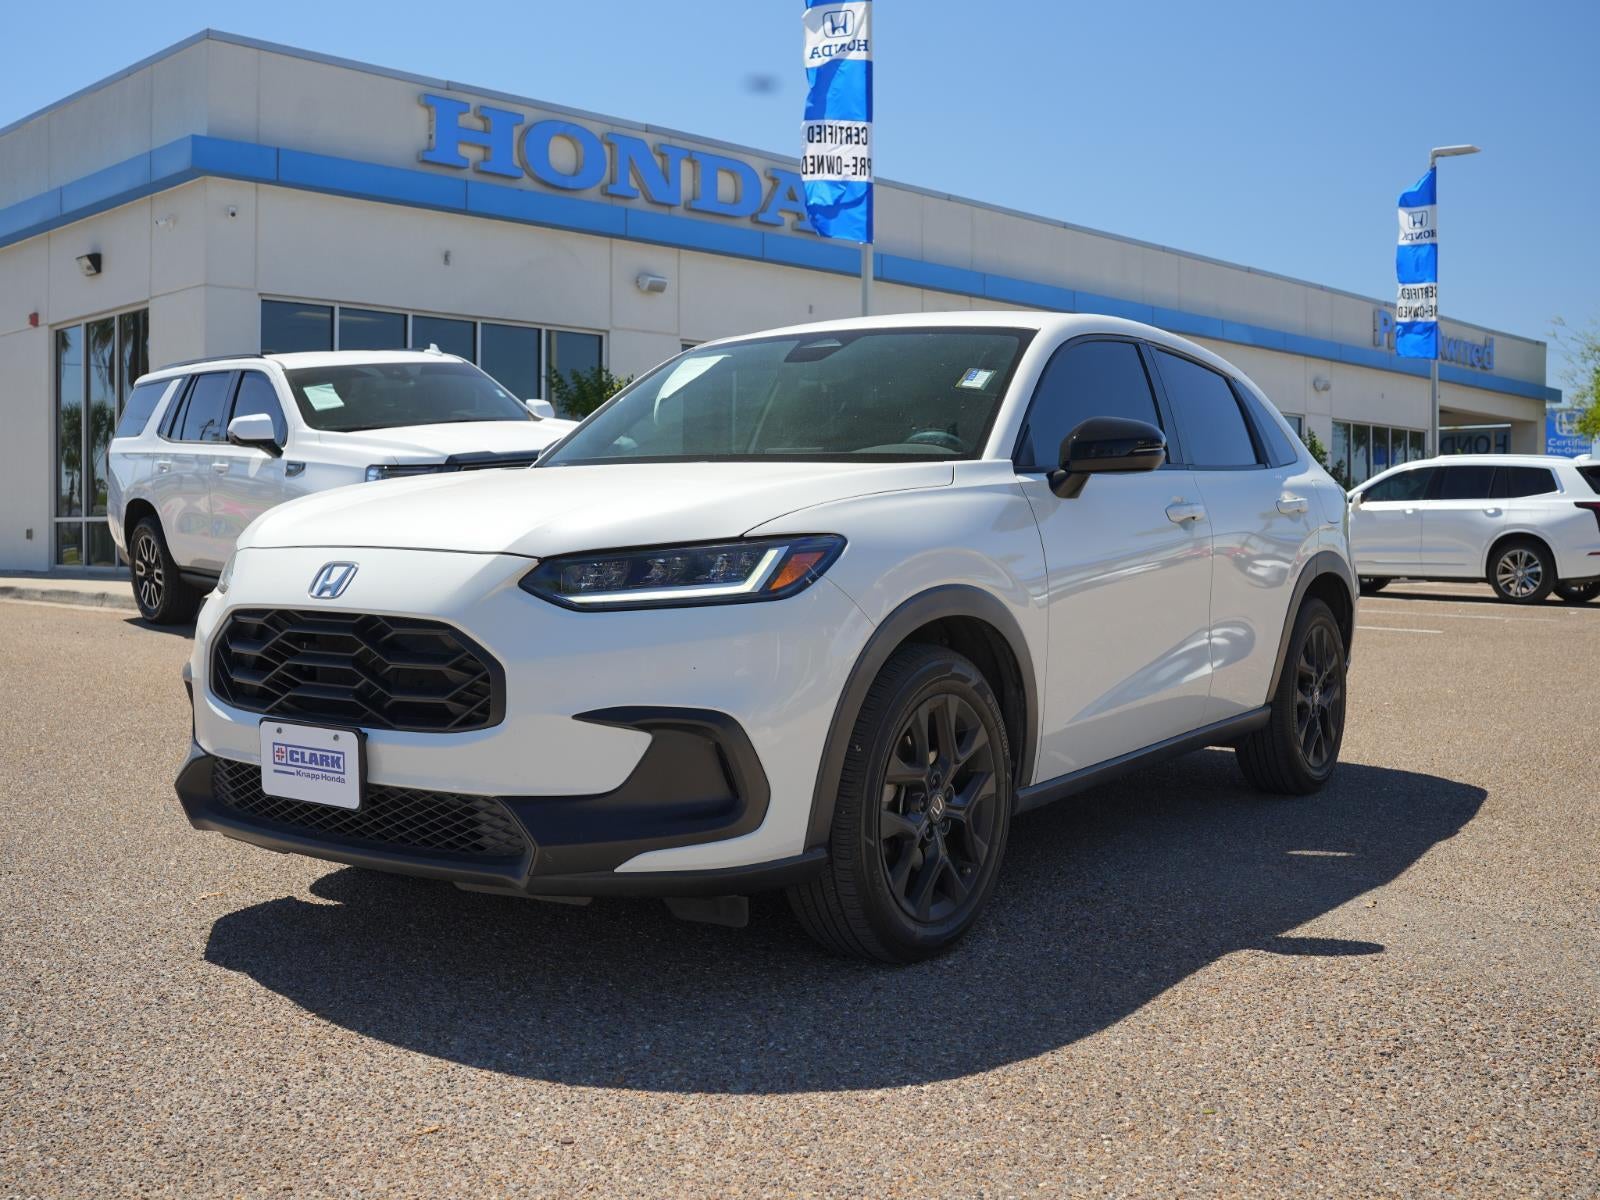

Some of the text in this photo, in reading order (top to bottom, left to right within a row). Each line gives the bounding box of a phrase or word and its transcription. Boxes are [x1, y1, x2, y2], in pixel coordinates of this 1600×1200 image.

[418, 93, 814, 234] HONDA
[289, 749, 342, 770] CLARK
[296, 769, 346, 784] Knapp Honda
